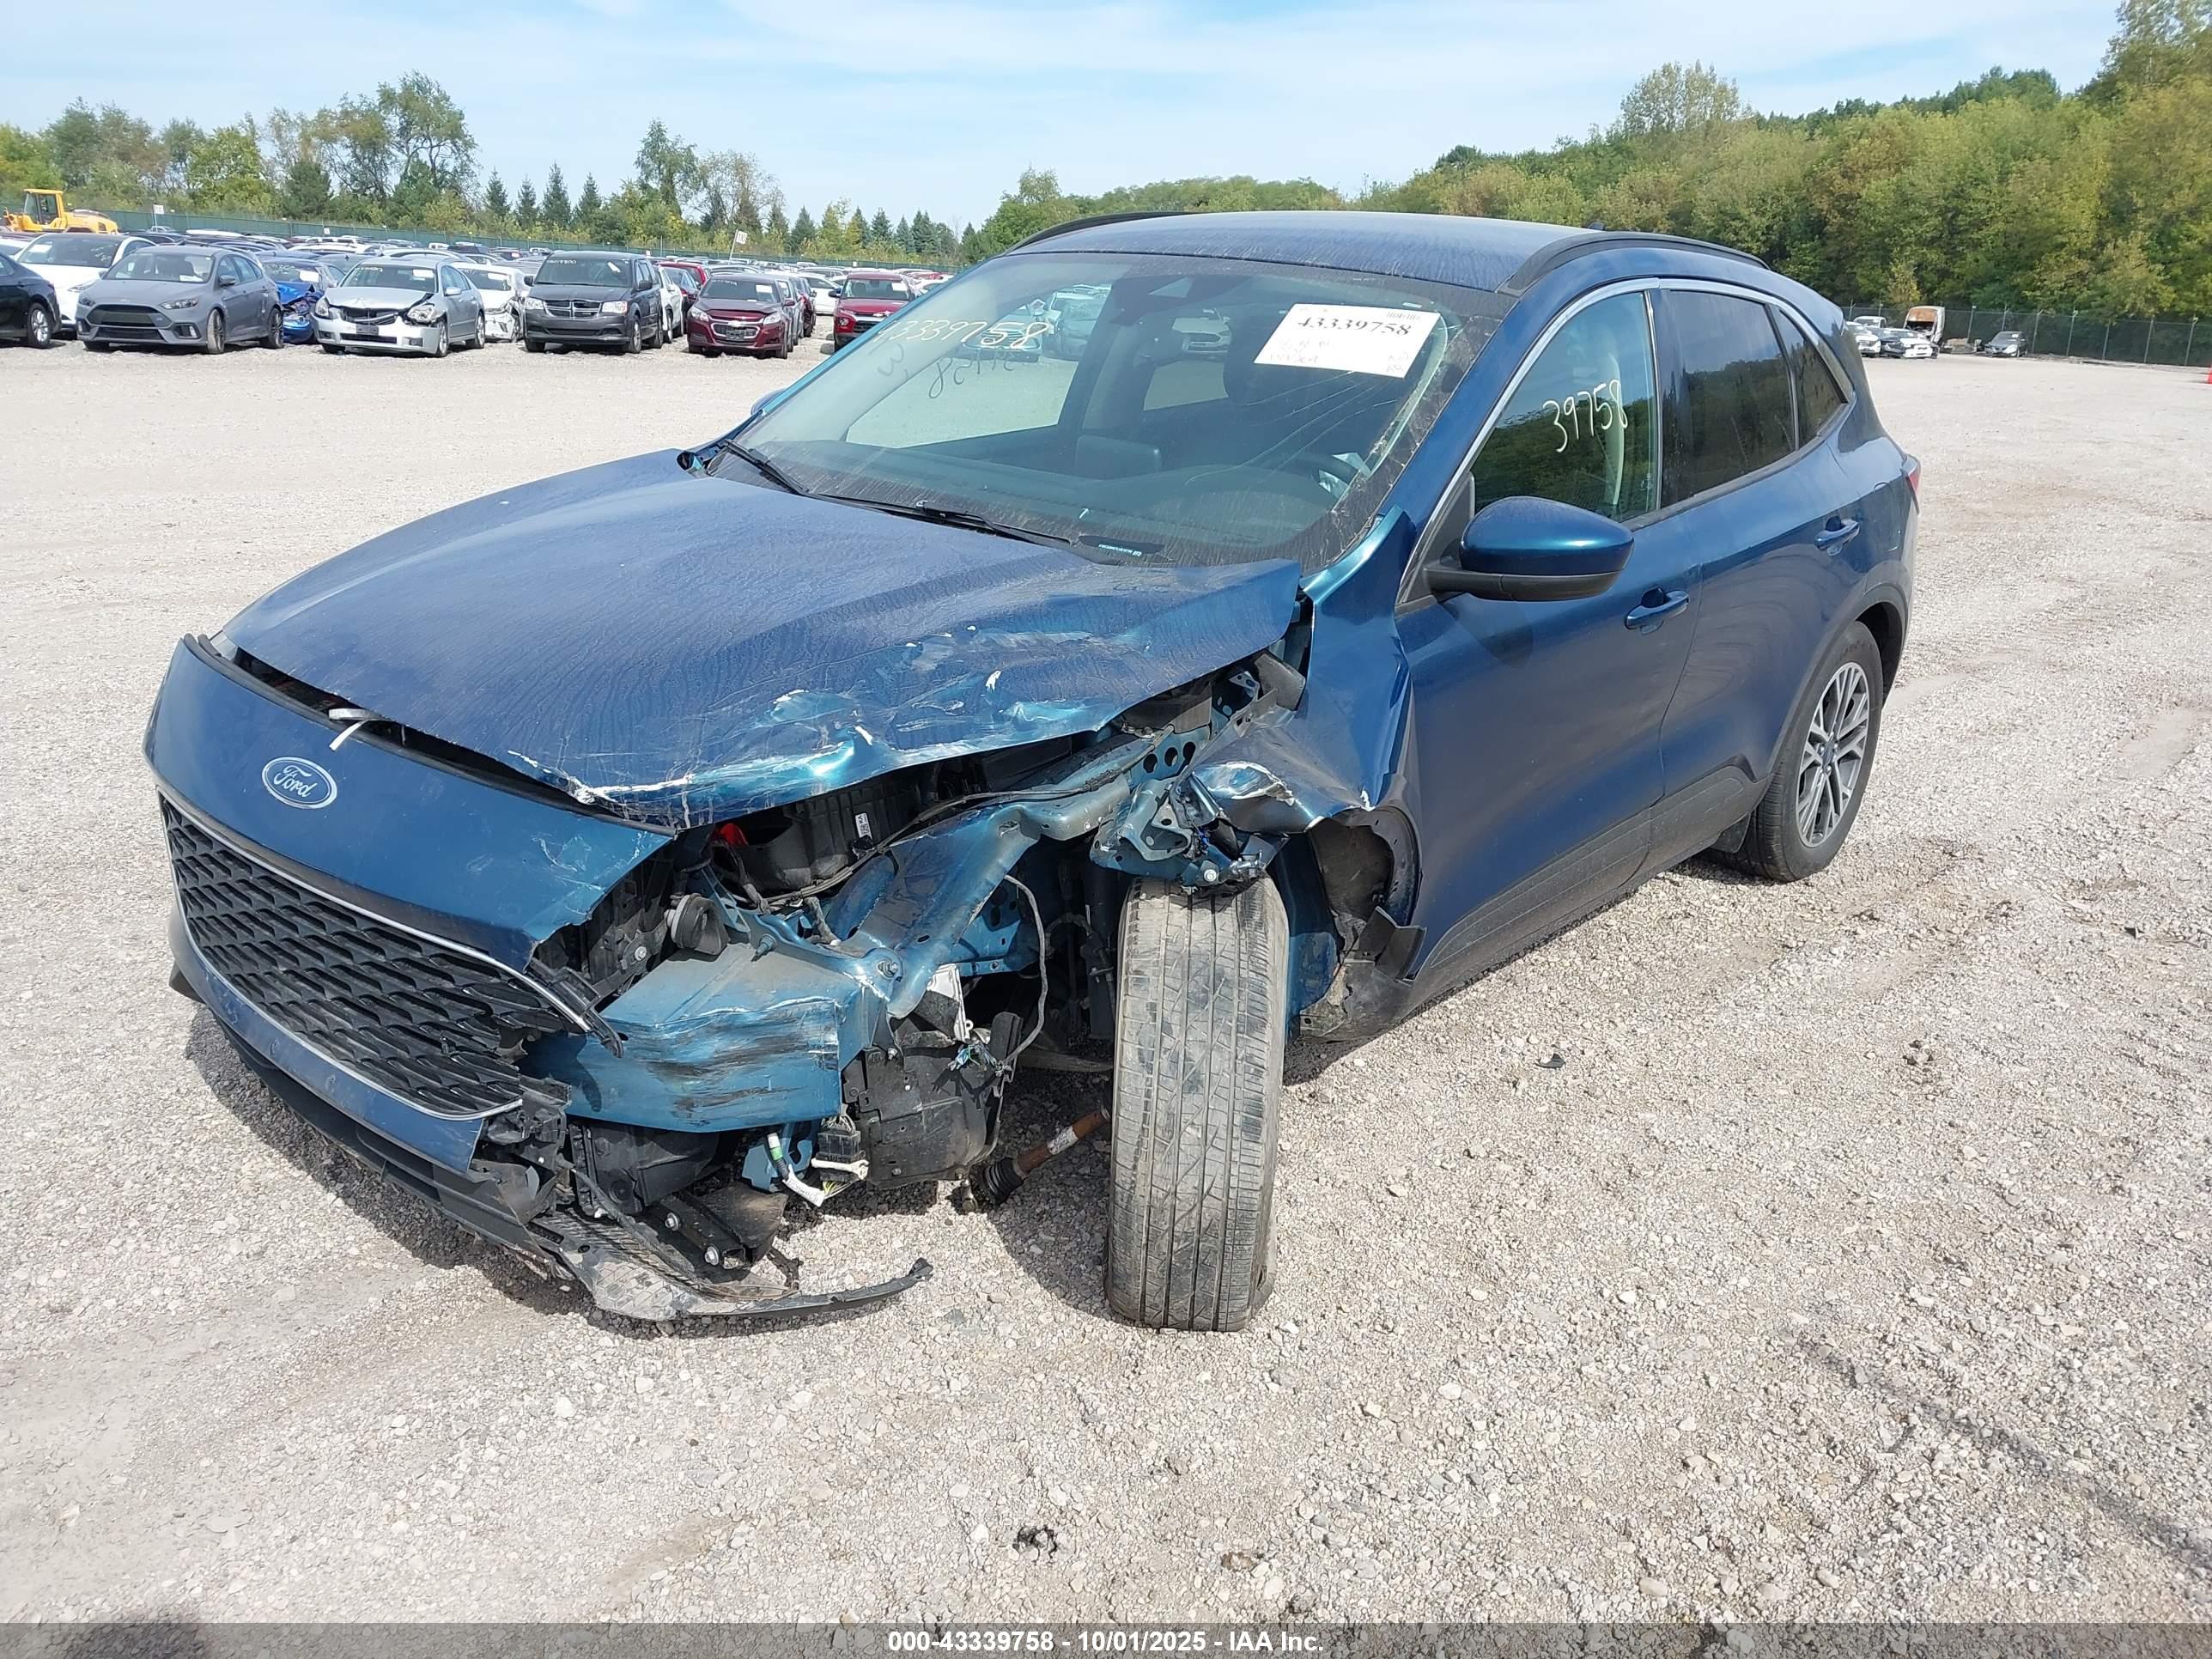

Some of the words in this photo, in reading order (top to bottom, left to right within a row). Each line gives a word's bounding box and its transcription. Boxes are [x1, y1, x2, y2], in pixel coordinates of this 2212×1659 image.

[1297, 316, 1412, 336] 43339758
[1542, 379, 1628, 453] 39758
[274, 764, 318, 798] Ford
